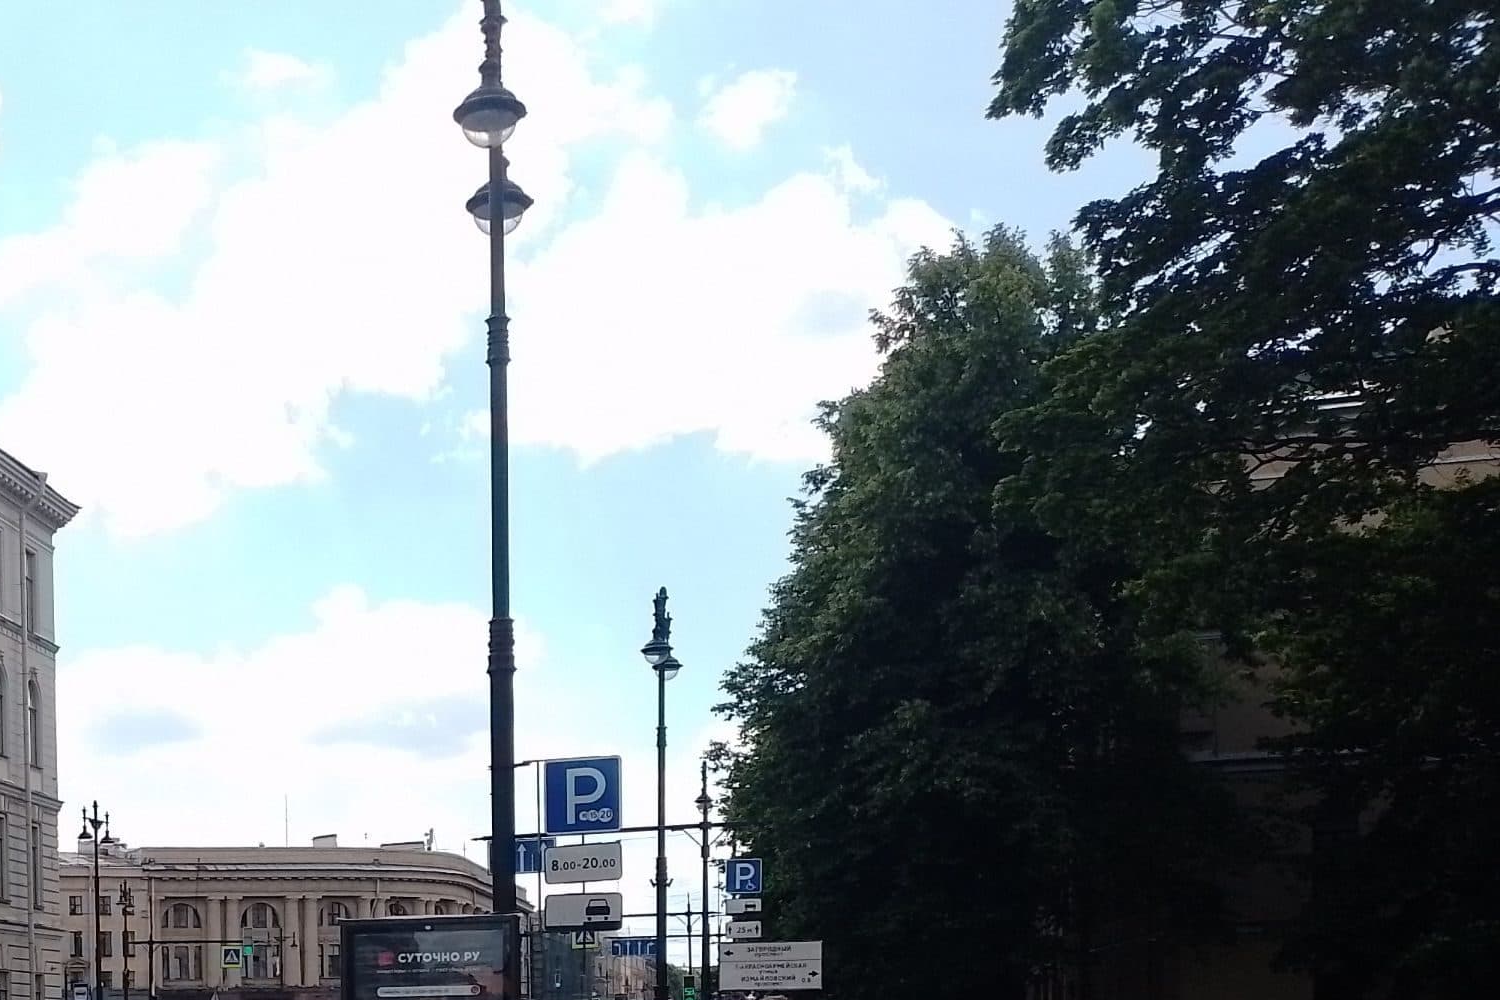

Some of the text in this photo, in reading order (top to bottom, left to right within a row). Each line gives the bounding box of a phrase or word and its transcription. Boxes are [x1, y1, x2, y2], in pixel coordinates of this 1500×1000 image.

[566, 767, 607, 825] P
[551, 857, 616, 871] 8.00-20.00
[735, 863, 755, 890] P
